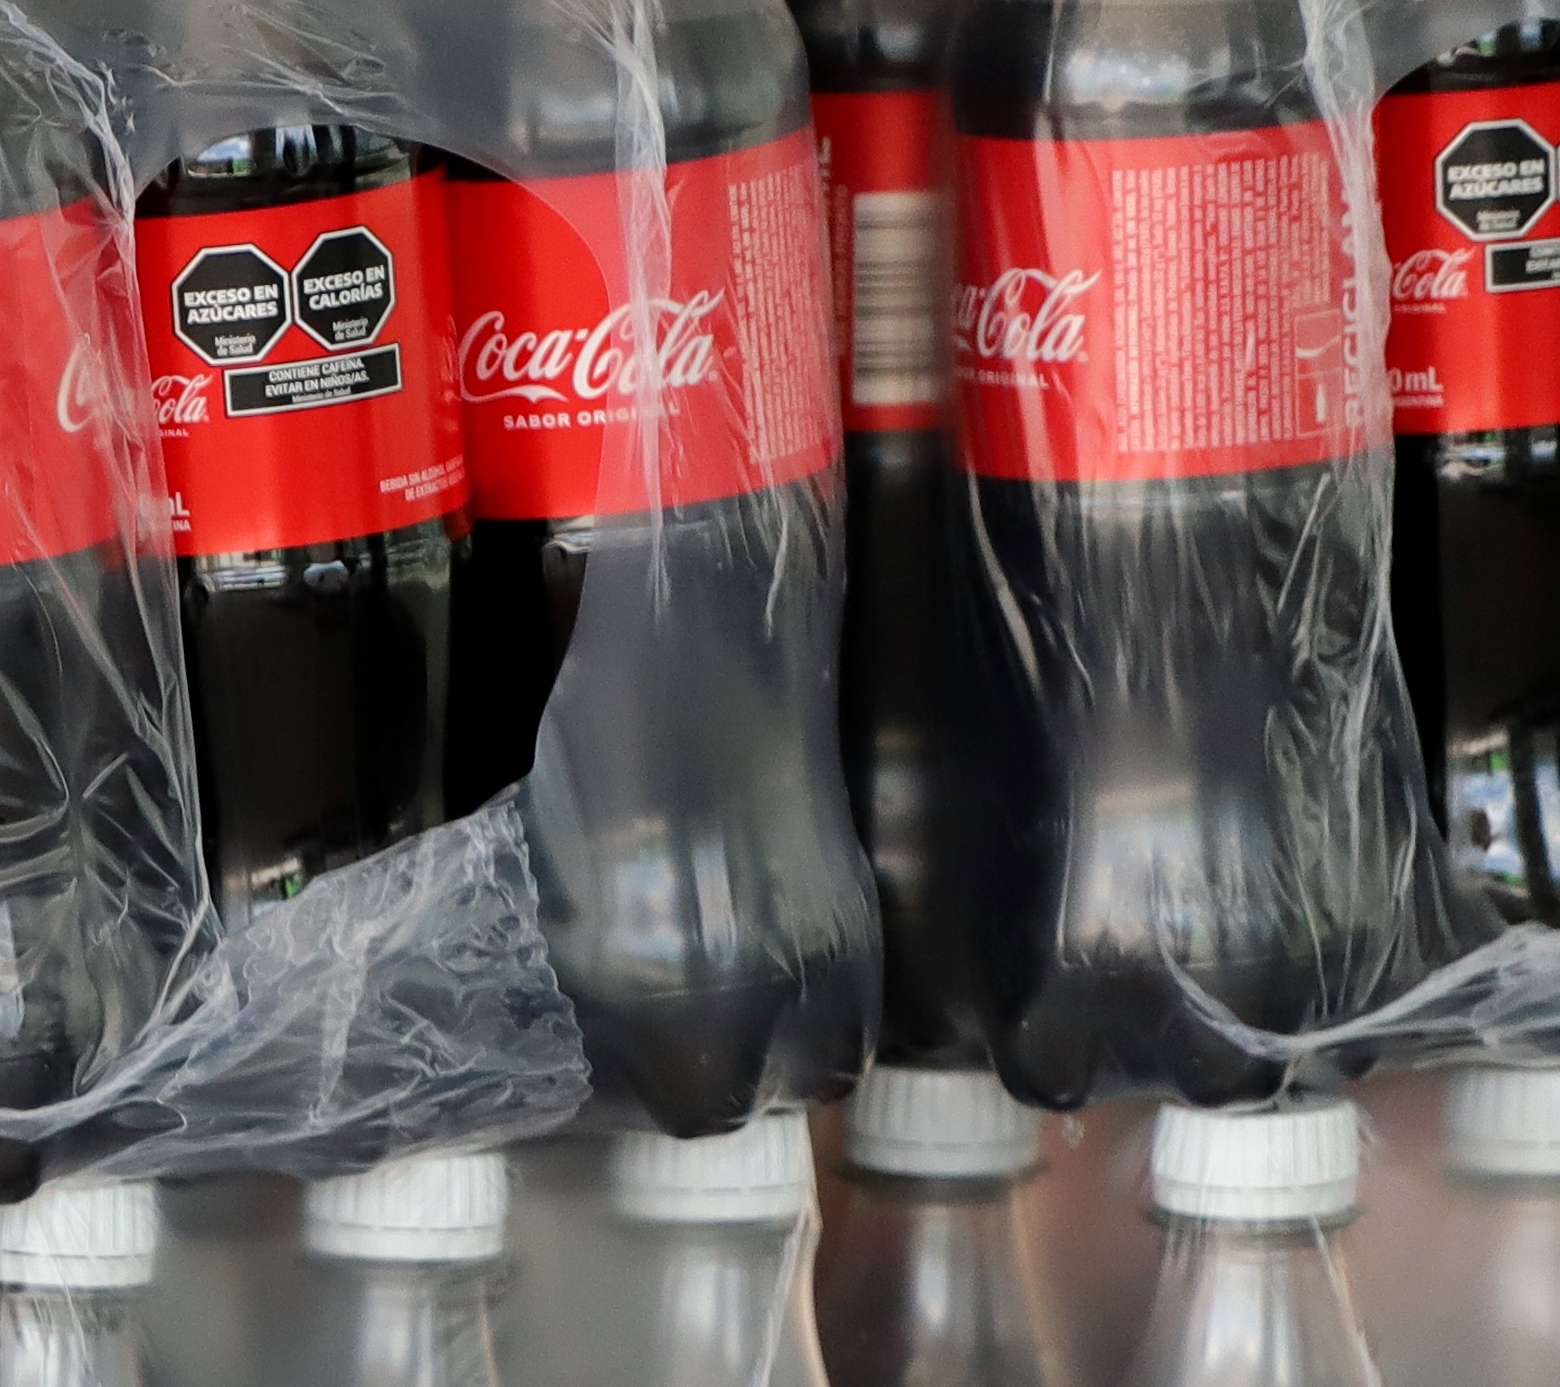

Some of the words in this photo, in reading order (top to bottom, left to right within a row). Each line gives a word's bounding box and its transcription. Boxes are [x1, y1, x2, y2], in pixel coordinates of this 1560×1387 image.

[1447, 162, 1518, 183] EXCESO
[1520, 158, 1546, 176] EN
[304, 271, 363, 295] EXCESO
[365, 265, 385, 282] EN
[184, 288, 251, 306] EXCESO
[254, 284, 279, 300] EN
[309, 283, 383, 310] CALORÍAS
[187, 301, 279, 324] AZÚCARES
[458, 288, 724, 402] Coca-Cola
[268, 364, 320, 382] CONTIENE
[265, 380, 303, 397] EVITAR
[304, 379, 319, 391] EN
[503, 411, 572, 430] SABOR
